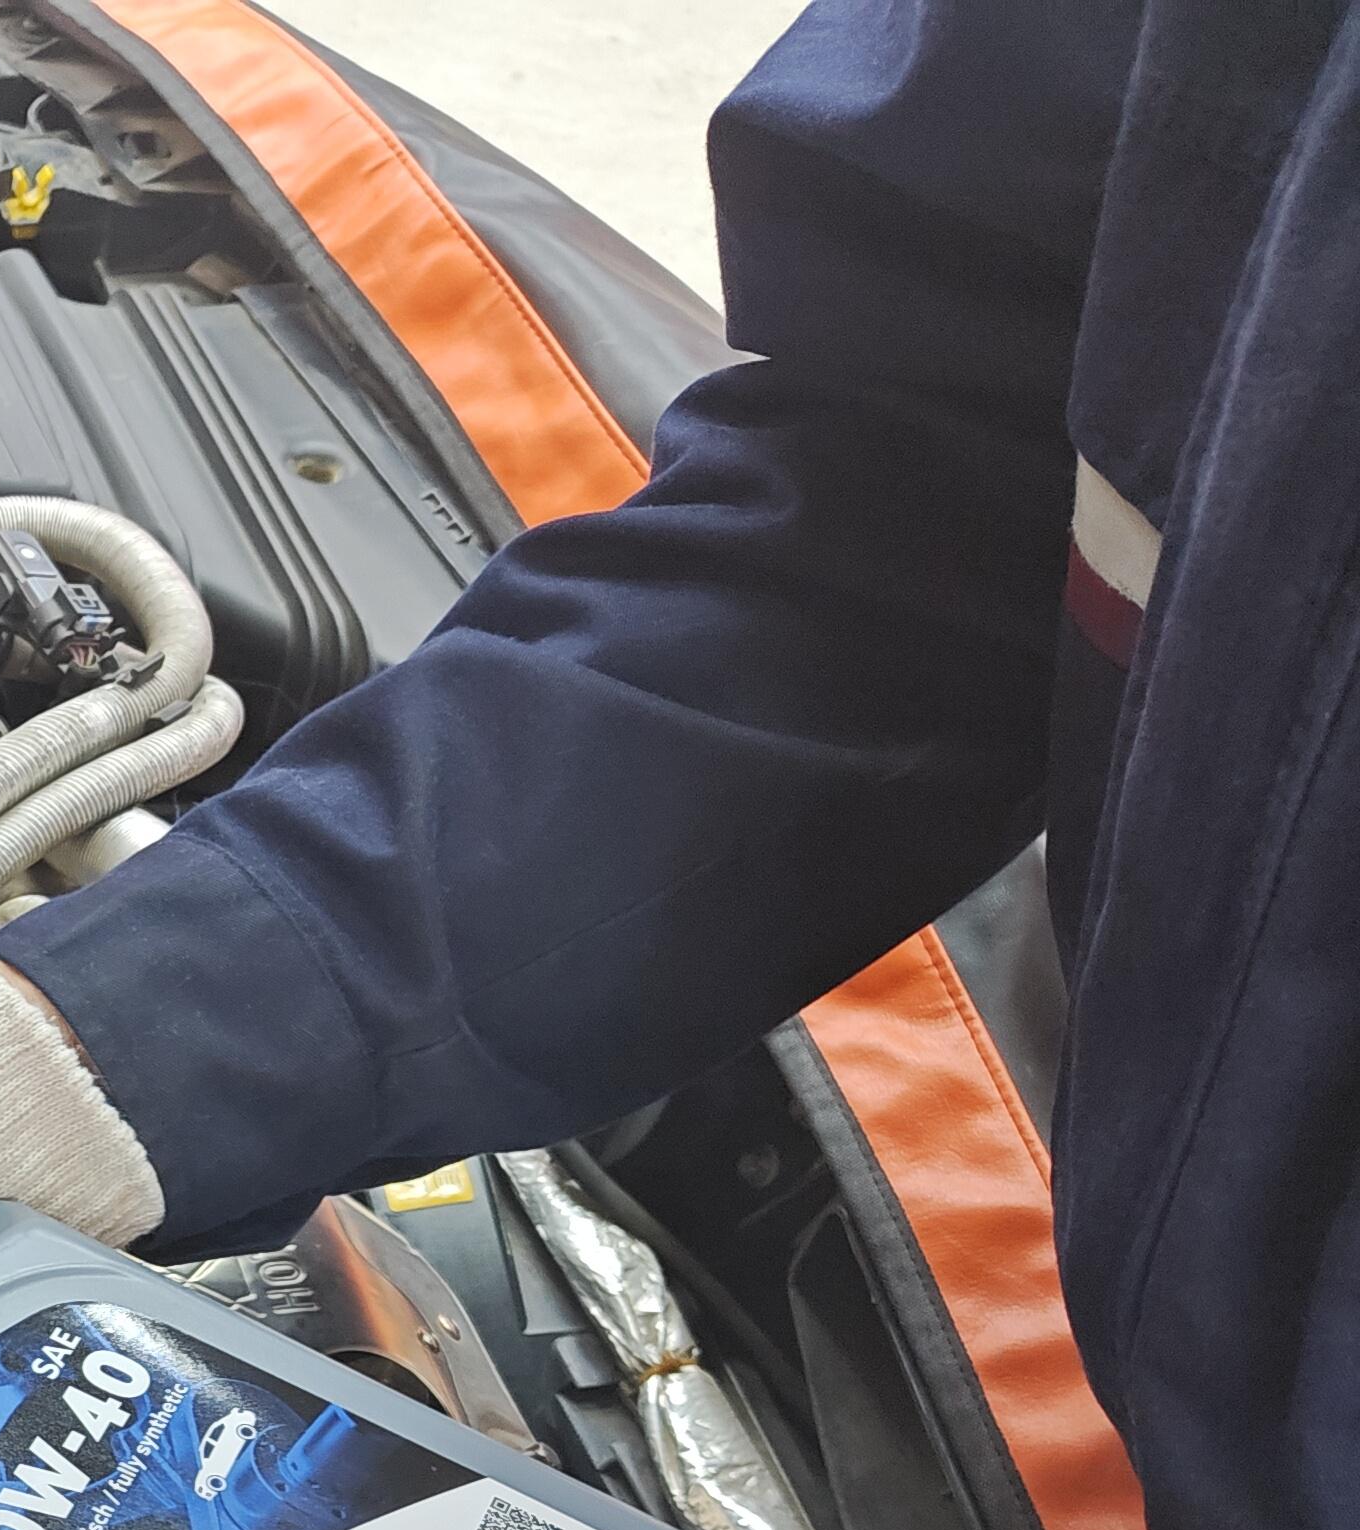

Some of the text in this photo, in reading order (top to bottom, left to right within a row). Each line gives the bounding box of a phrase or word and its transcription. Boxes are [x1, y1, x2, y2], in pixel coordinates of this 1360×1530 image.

[31, 1326, 81, 1381] SAE
[108, 1454, 149, 1494] fully
[135, 1383, 189, 1457] synthetic
